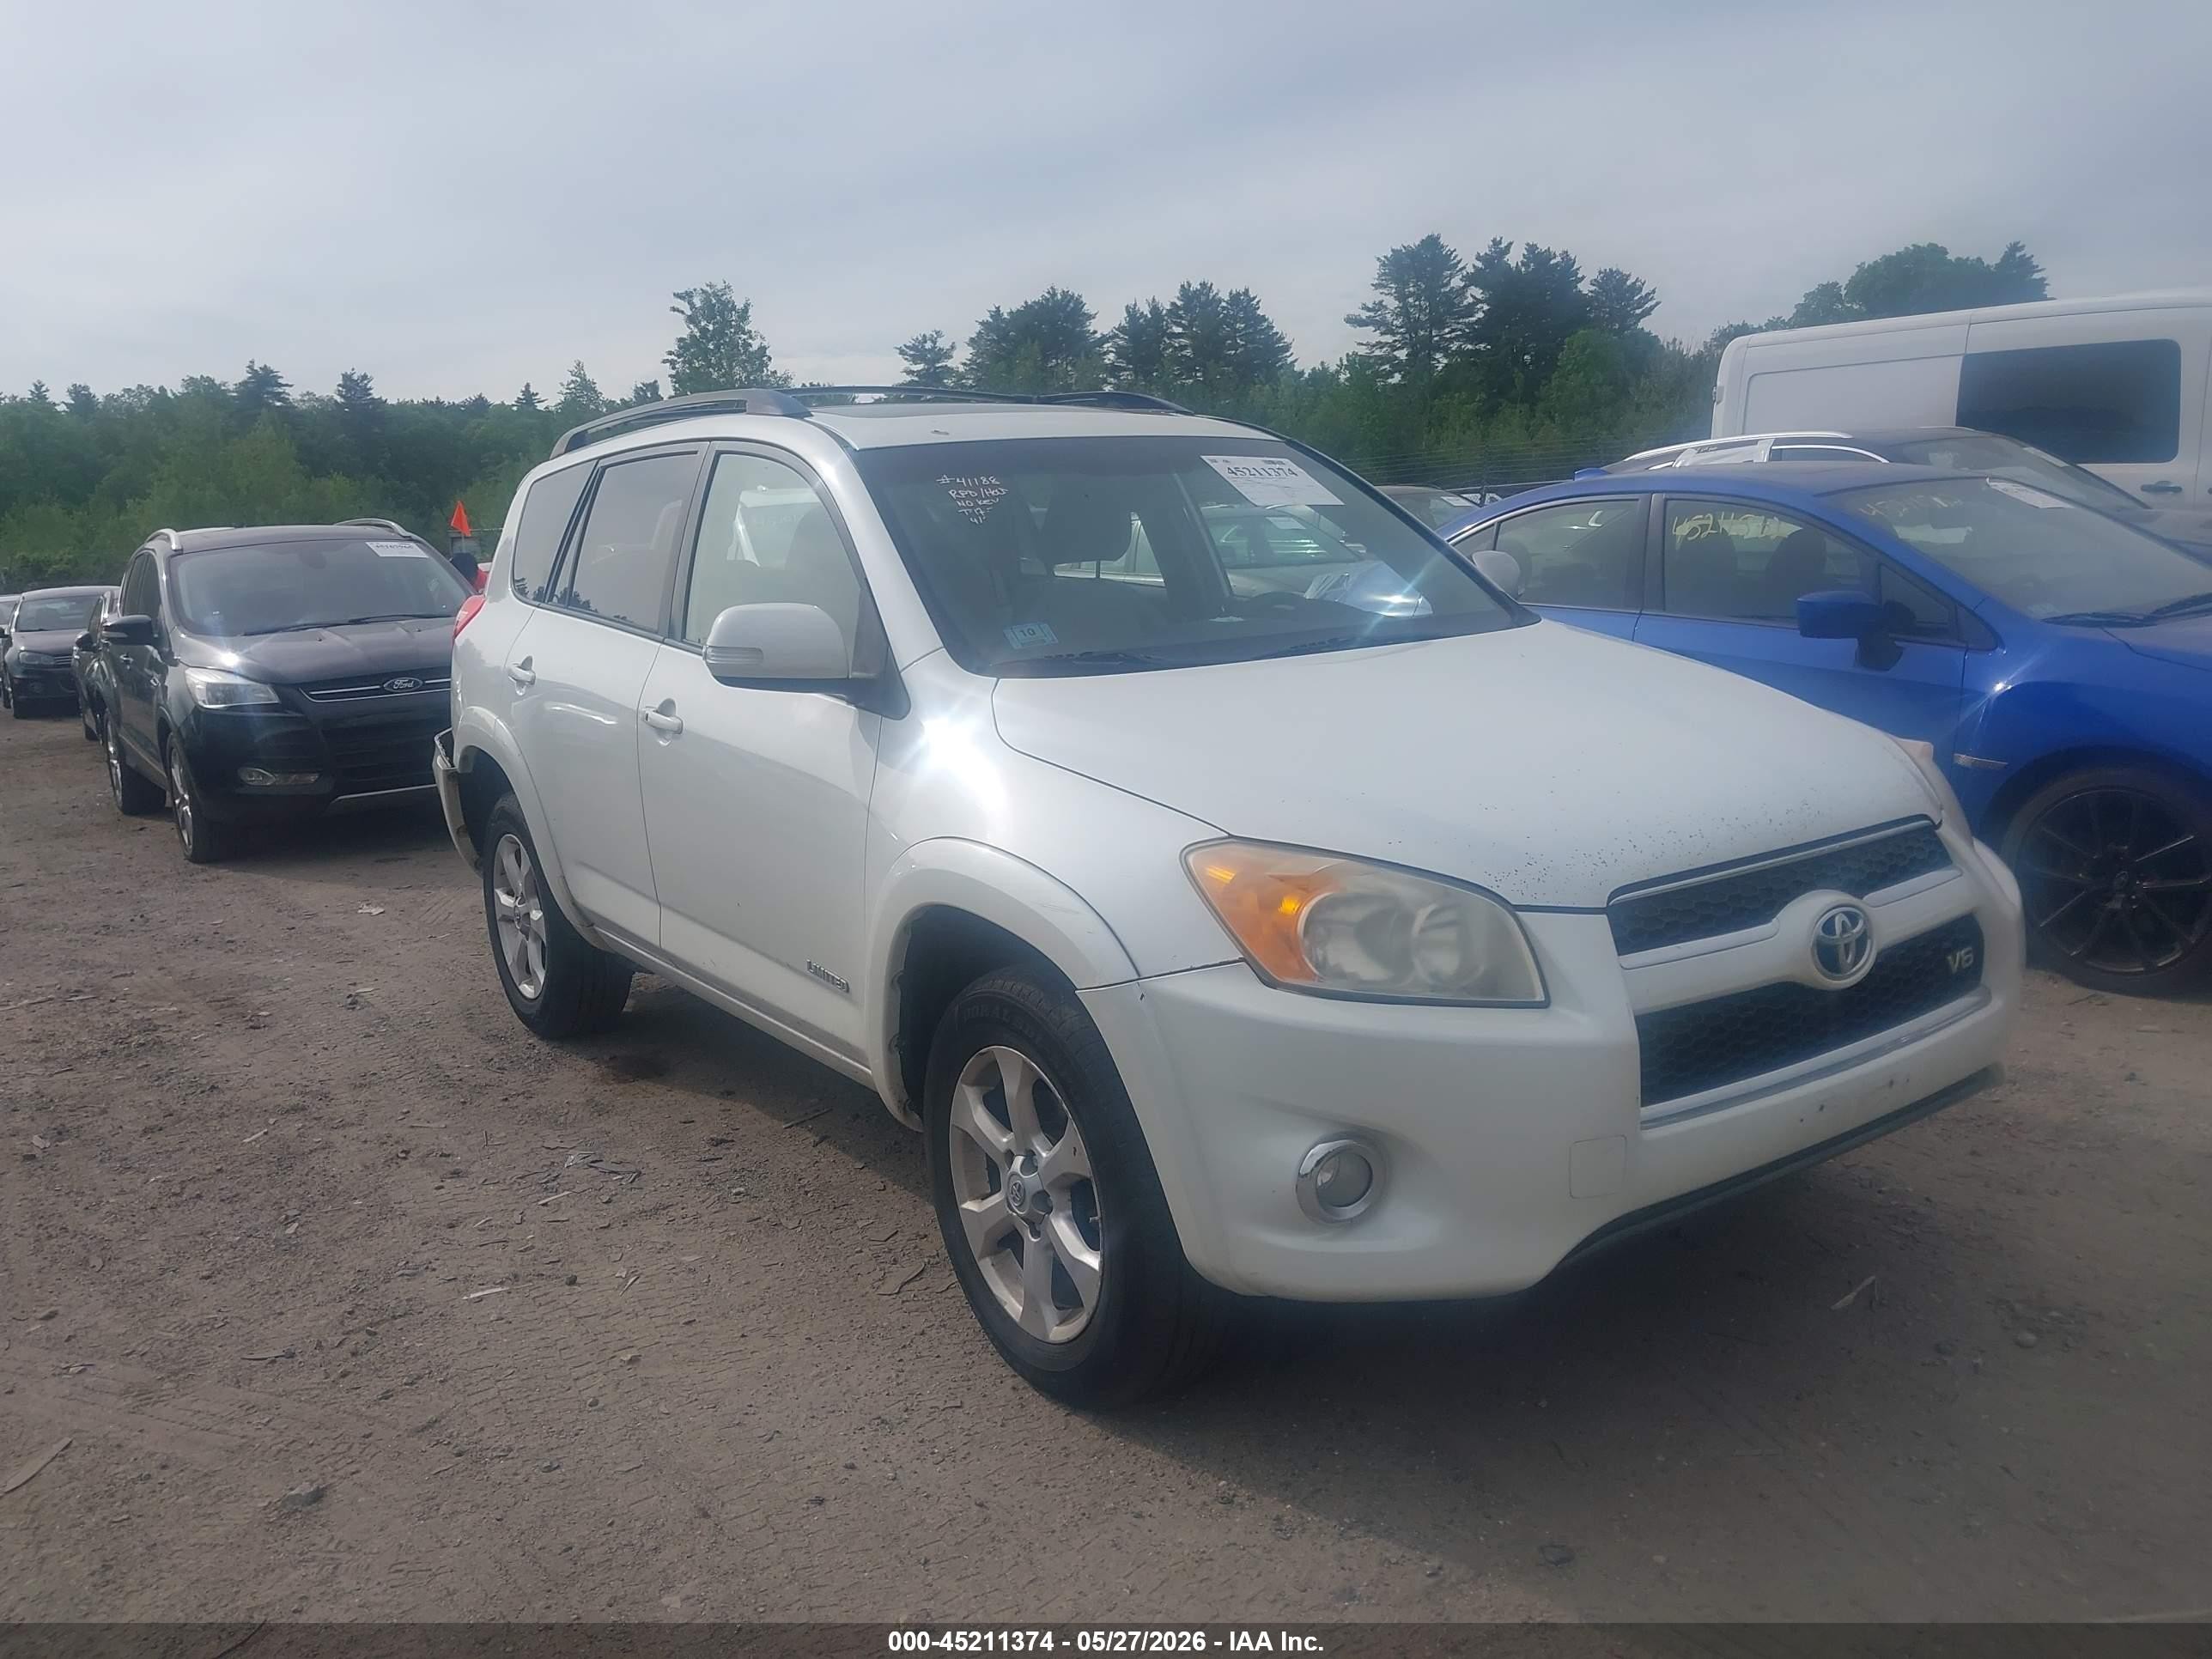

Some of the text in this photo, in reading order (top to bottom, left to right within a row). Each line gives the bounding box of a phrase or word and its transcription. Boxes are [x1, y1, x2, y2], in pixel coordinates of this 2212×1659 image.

[1227, 466, 1298, 477] 45211374
[393, 678, 415, 689] Ford
[1946, 946, 1974, 975] V6
